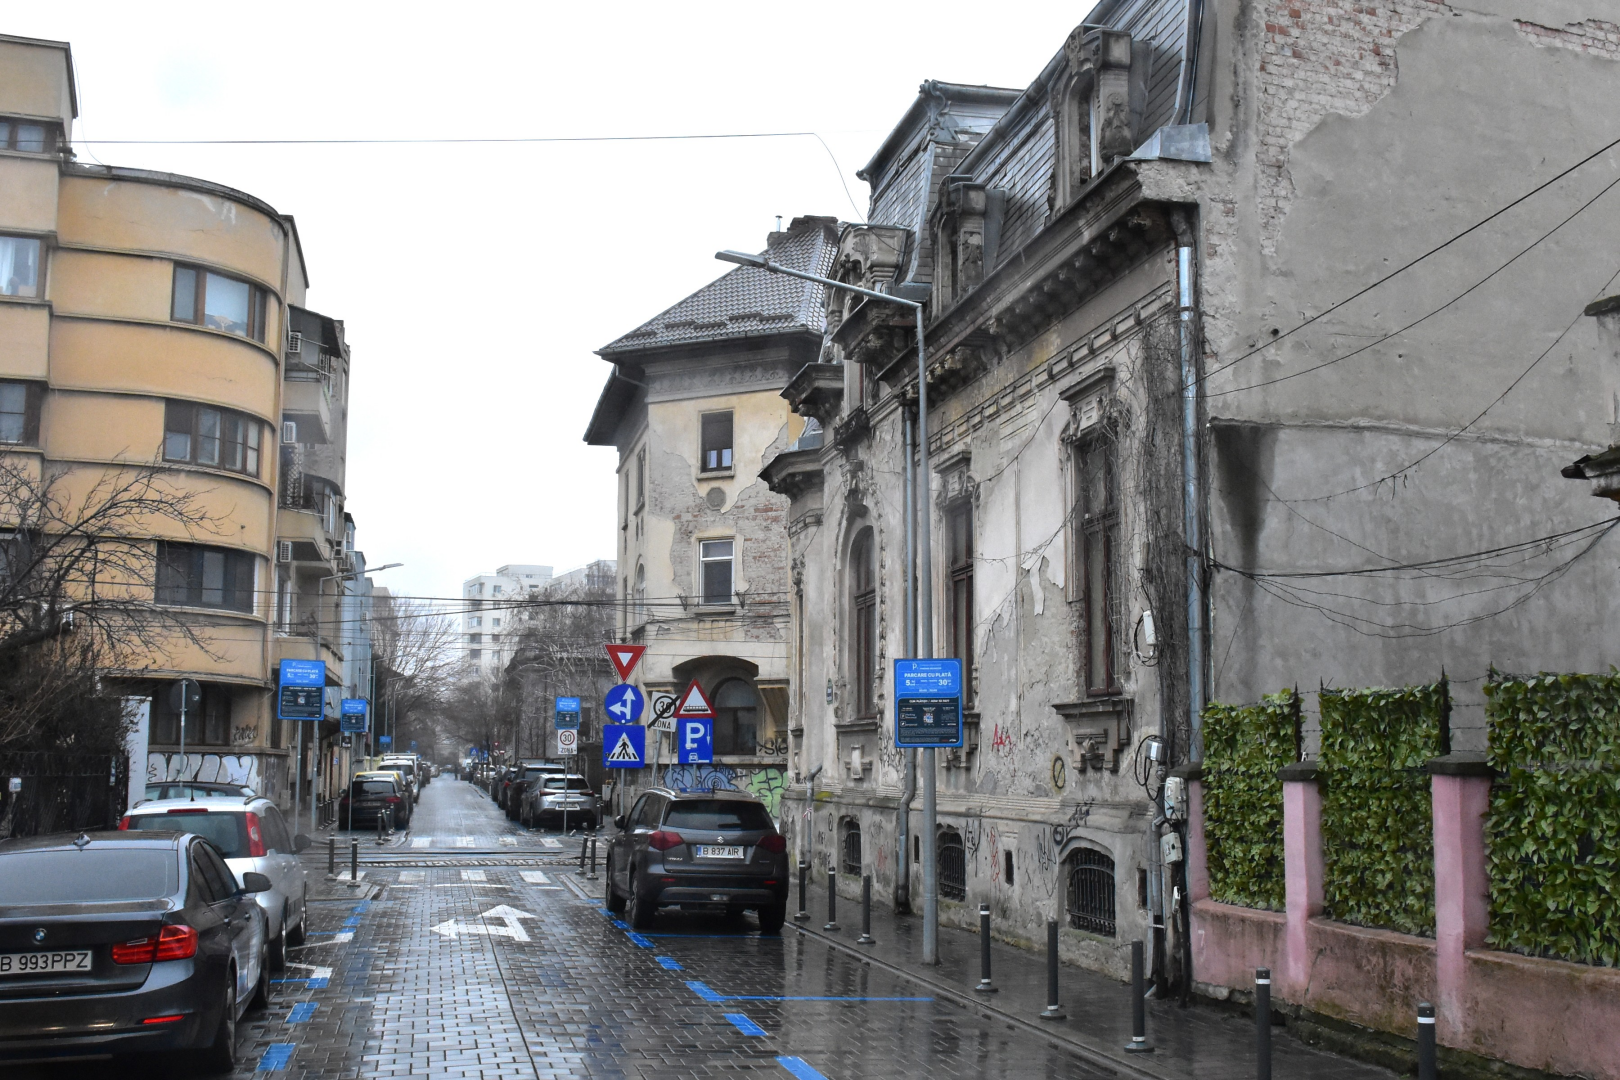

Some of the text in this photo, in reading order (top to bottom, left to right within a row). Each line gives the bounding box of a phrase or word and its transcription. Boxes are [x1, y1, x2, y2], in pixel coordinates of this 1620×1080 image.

[562, 733, 572, 742] 30
[685, 722, 705, 749] P
[702, 847, 739, 856] B 837 AIR
[0, 956, 12, 972] B
